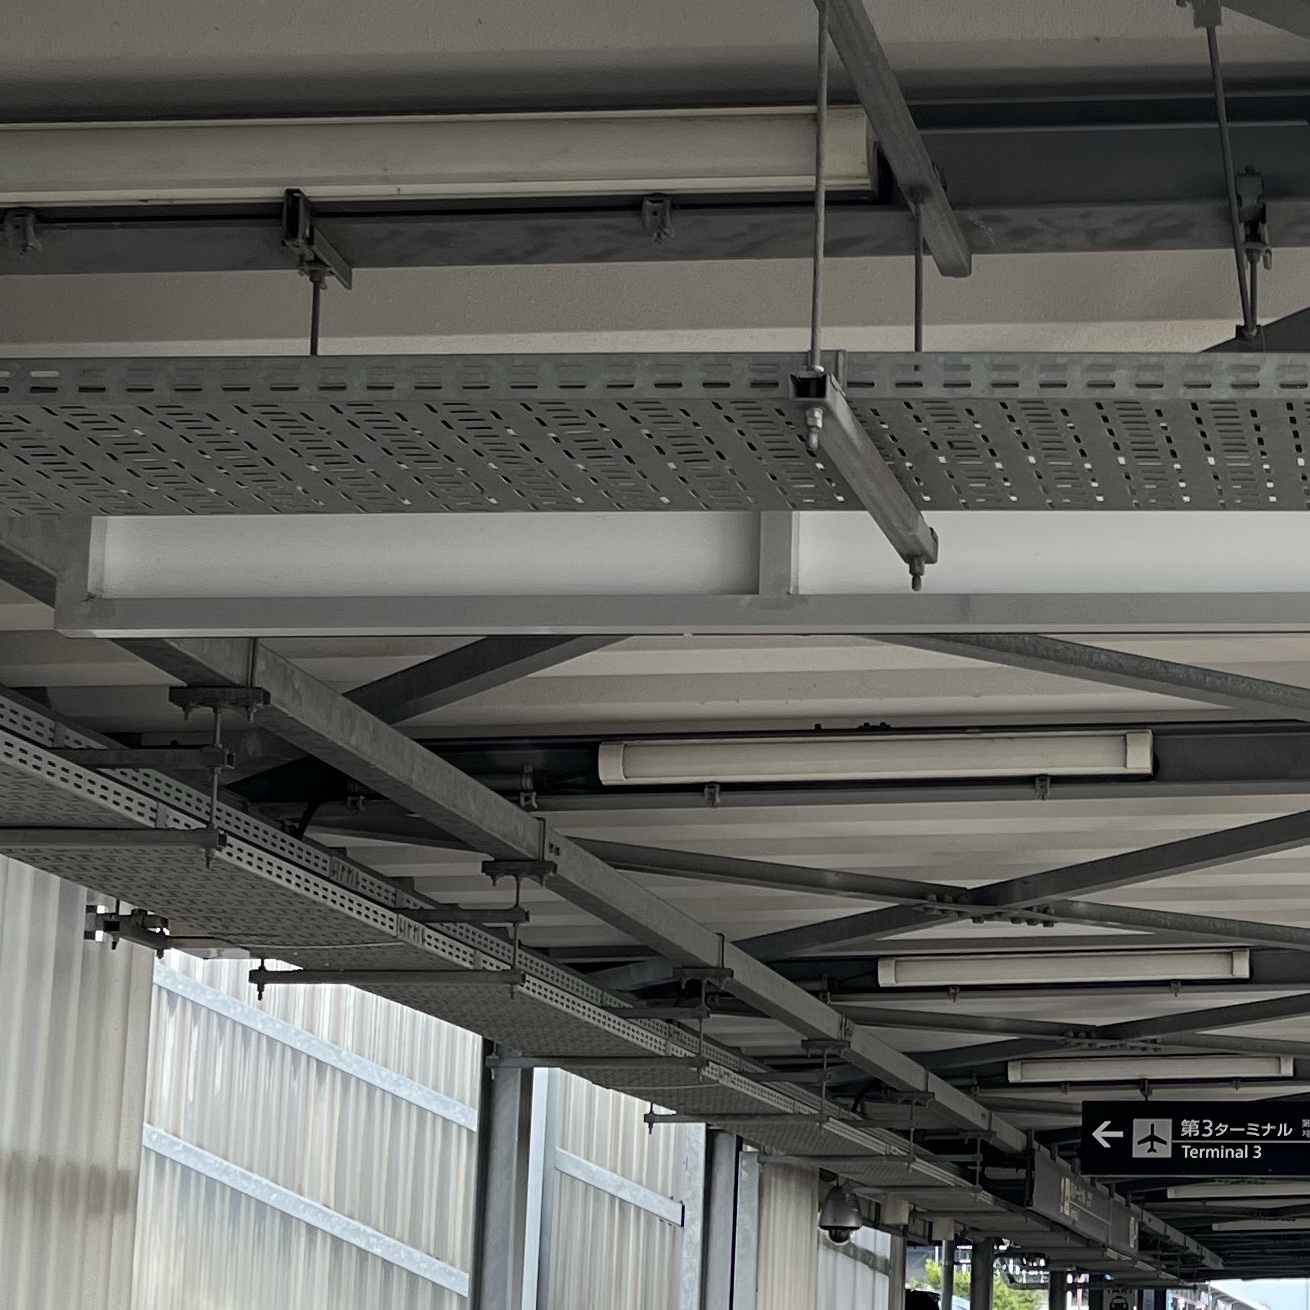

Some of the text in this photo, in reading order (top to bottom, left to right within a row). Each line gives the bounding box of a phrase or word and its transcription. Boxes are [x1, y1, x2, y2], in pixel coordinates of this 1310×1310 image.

[1180, 1118, 1293, 1138] 第3ターミナル
[1180, 1144, 1262, 1159] Terminal 3
